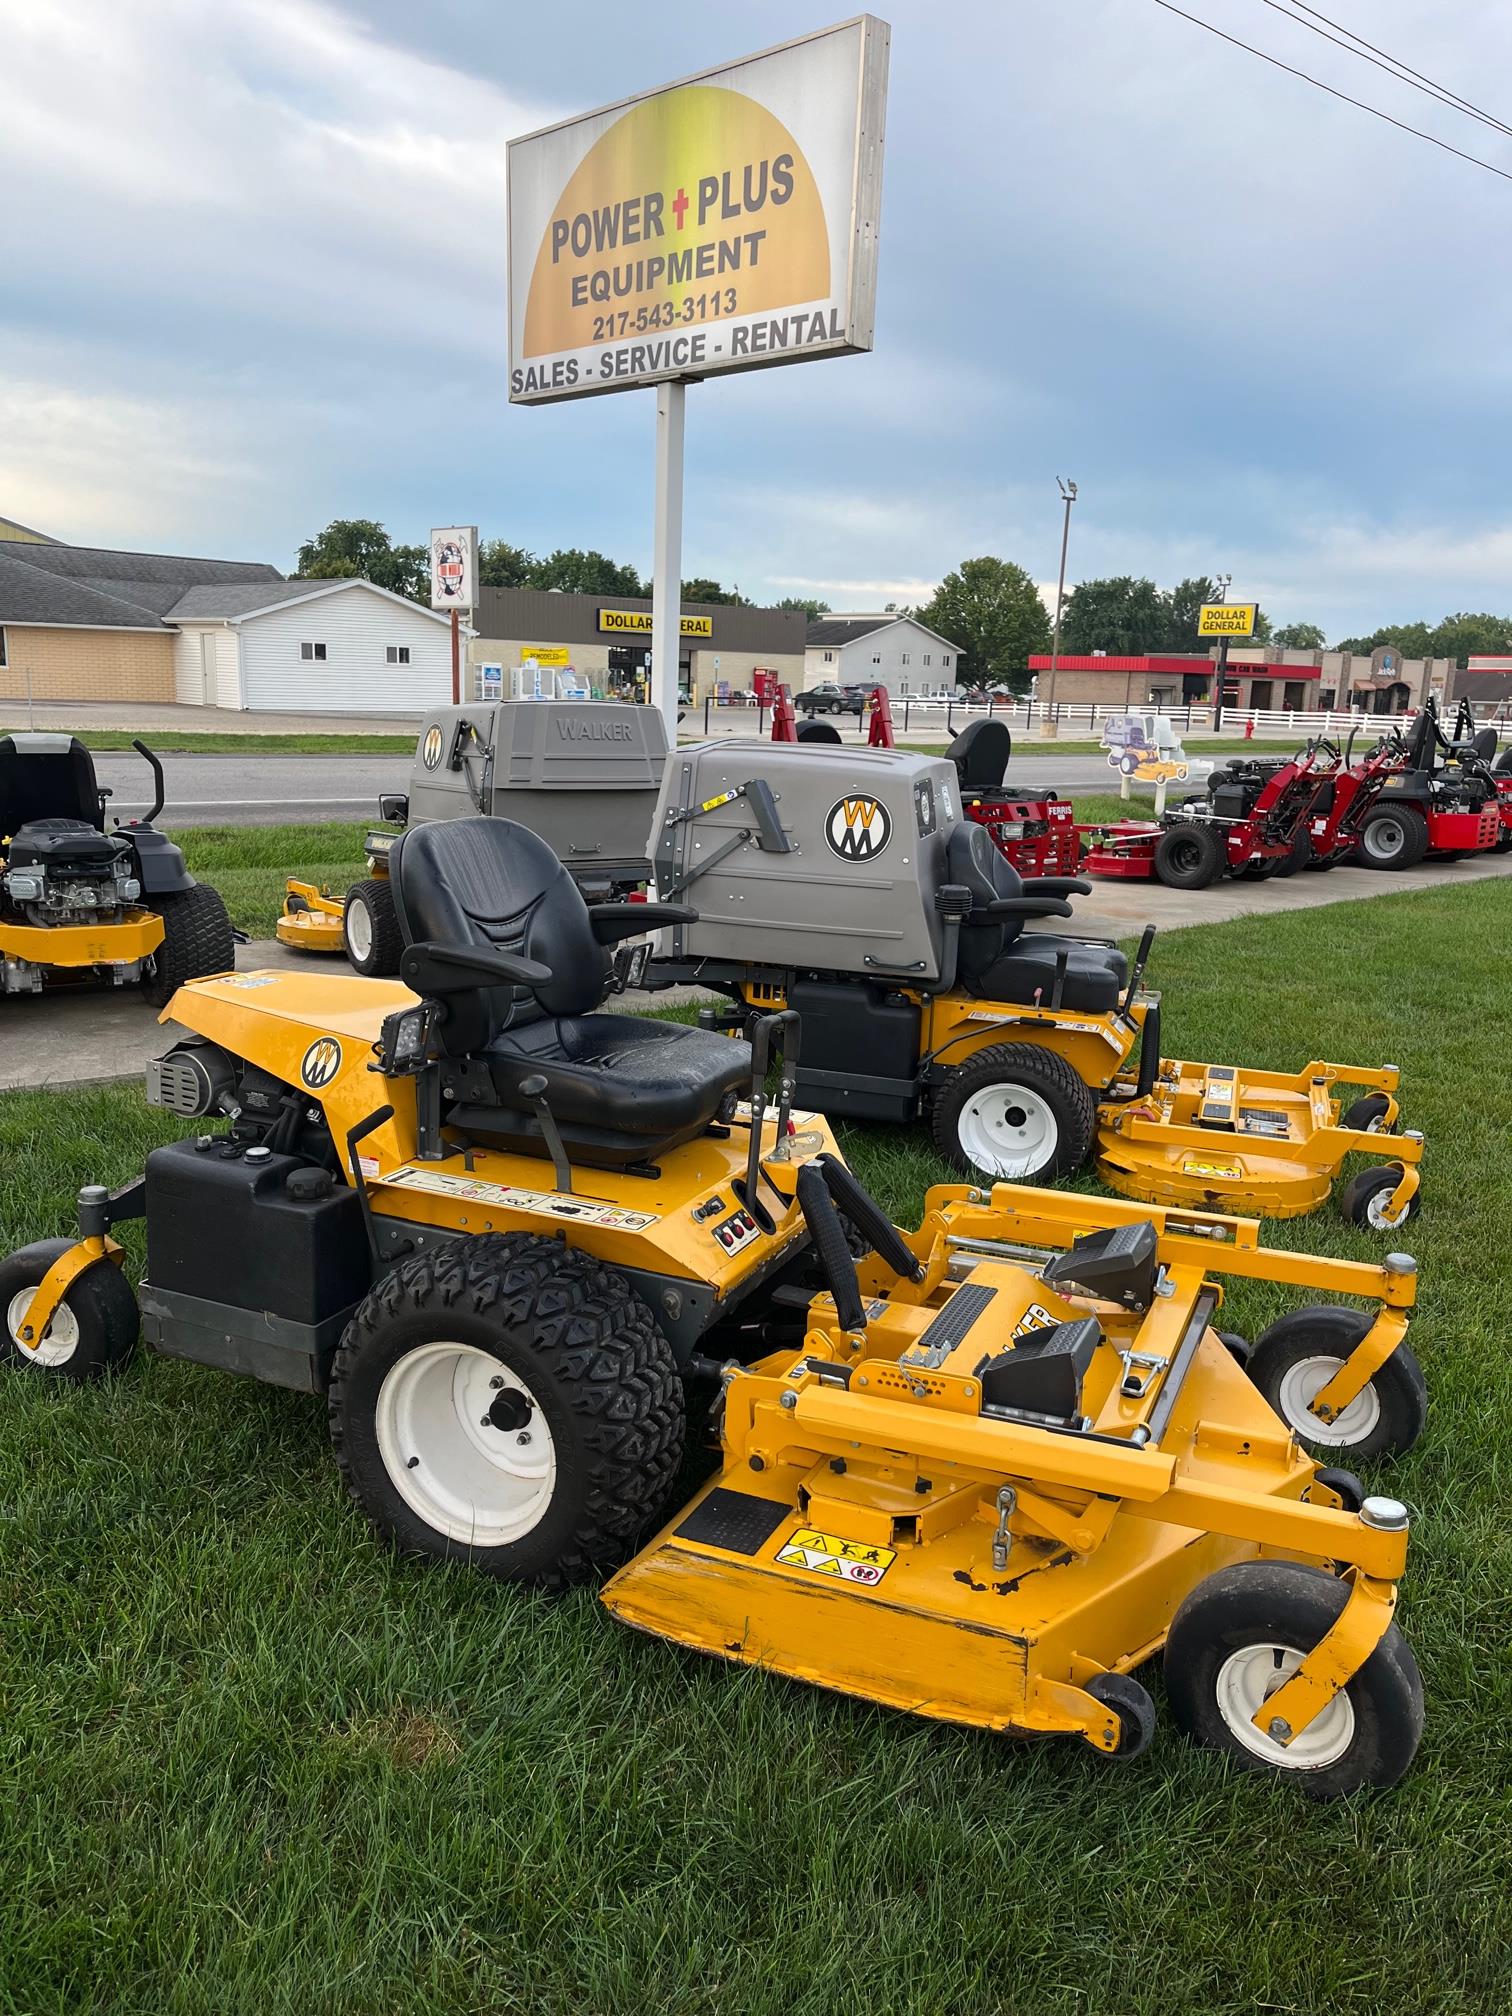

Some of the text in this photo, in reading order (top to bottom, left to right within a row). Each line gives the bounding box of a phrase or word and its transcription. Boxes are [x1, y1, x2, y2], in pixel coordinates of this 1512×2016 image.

[552, 153, 794, 264] POWER PLUS
[571, 230, 767, 307] EQUIPMENT
[592, 287, 737, 342] 217-543-3113
[511, 358, 579, 395] SALES
[600, 334, 706, 379] SERVICE
[731, 308, 845, 357] RENTAL
[606, 614, 709, 633] DOLLAR ERAL
[1203, 620, 1247, 631] GENERAL
[1206, 610, 1246, 620] DOLLAR
[556, 718, 632, 742] WALKER
[1048, 805, 1073, 816] FERRIS
